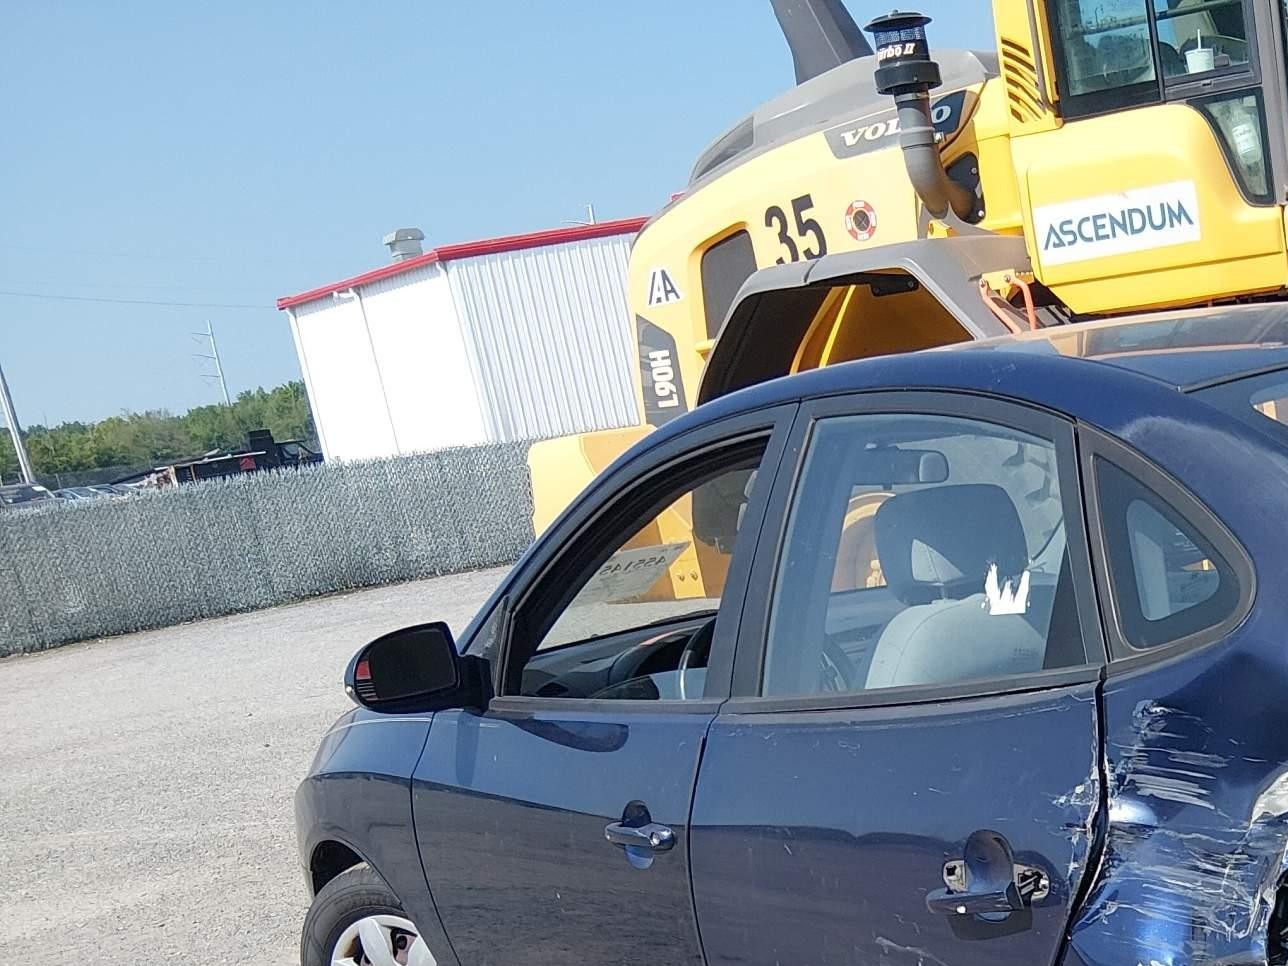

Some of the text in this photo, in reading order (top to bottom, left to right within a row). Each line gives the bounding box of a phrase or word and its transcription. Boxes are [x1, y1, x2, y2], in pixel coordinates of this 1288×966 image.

[840, 105, 952, 147] VOLO
[765, 193, 827, 265] 35
[1044, 200, 1194, 251] ASCENDUM
[648, 350, 679, 408] L90H
